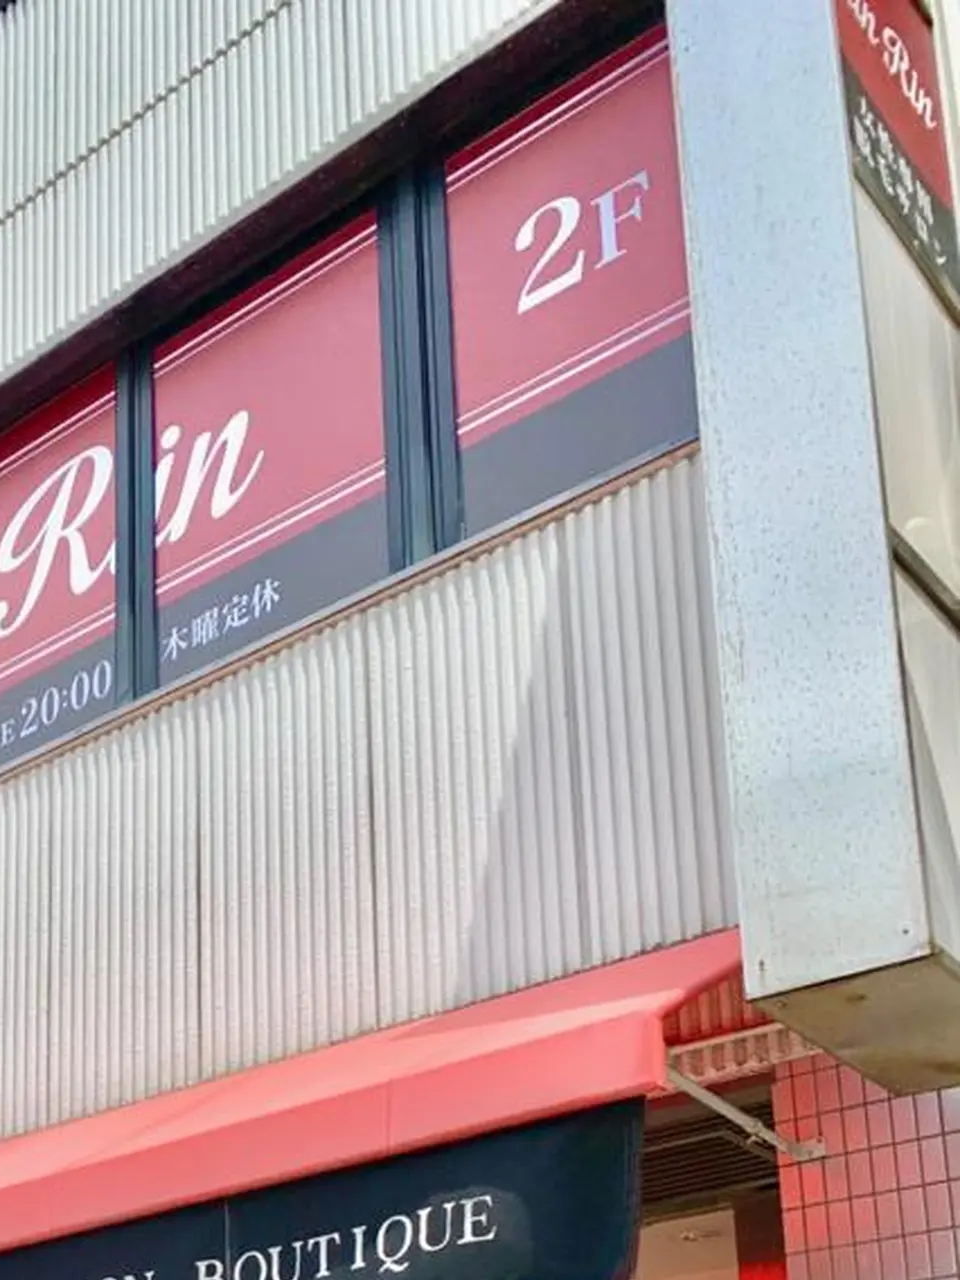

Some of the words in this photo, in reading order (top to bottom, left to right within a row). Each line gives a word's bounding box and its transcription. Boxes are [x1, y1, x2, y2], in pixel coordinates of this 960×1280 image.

[882, 26, 938, 129] Rin
[514, 170, 652, 315] 2F
[20, 660, 114, 735] 20:00
[161, 577, 283, 662] 木曜定休
